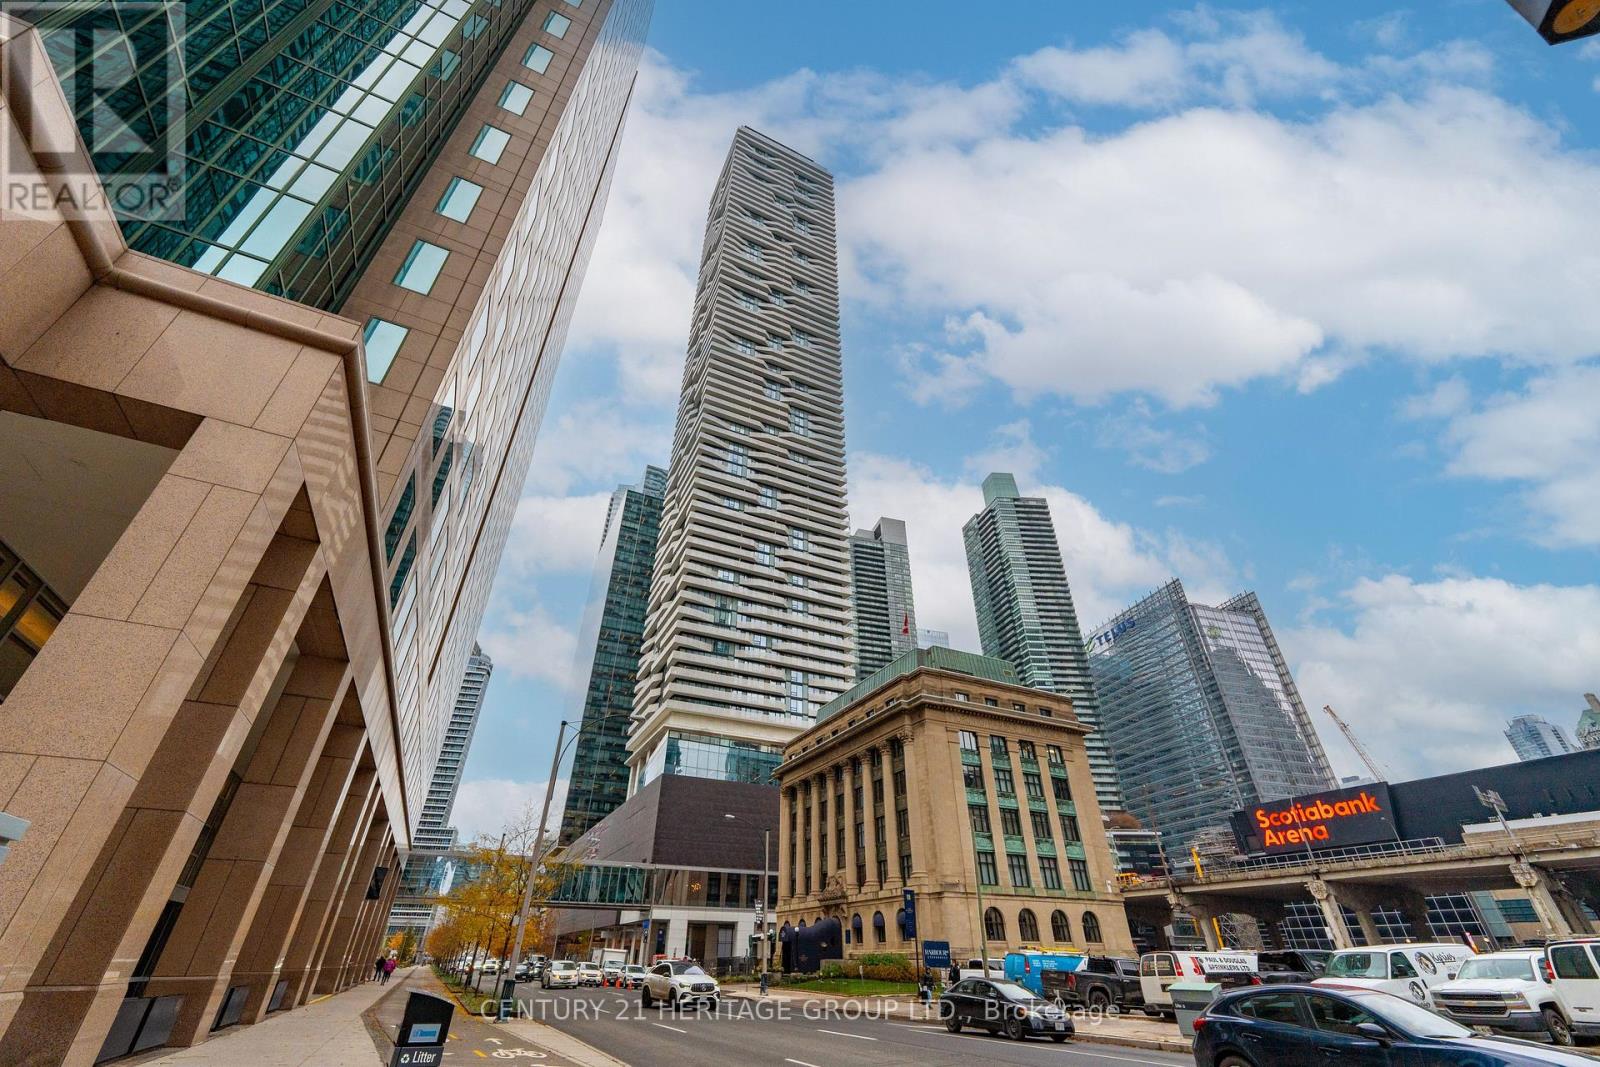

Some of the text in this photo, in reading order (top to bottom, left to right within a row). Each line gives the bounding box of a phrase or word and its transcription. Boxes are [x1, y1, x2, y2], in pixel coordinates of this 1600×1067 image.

[1095, 617, 1136, 646] TELUS
[1255, 792, 1382, 828] Scotiabank
[1264, 825, 1329, 847] Arena
[1224, 957, 1247, 965] DOUGLAS
[412, 1051, 437, 1063] Litter
